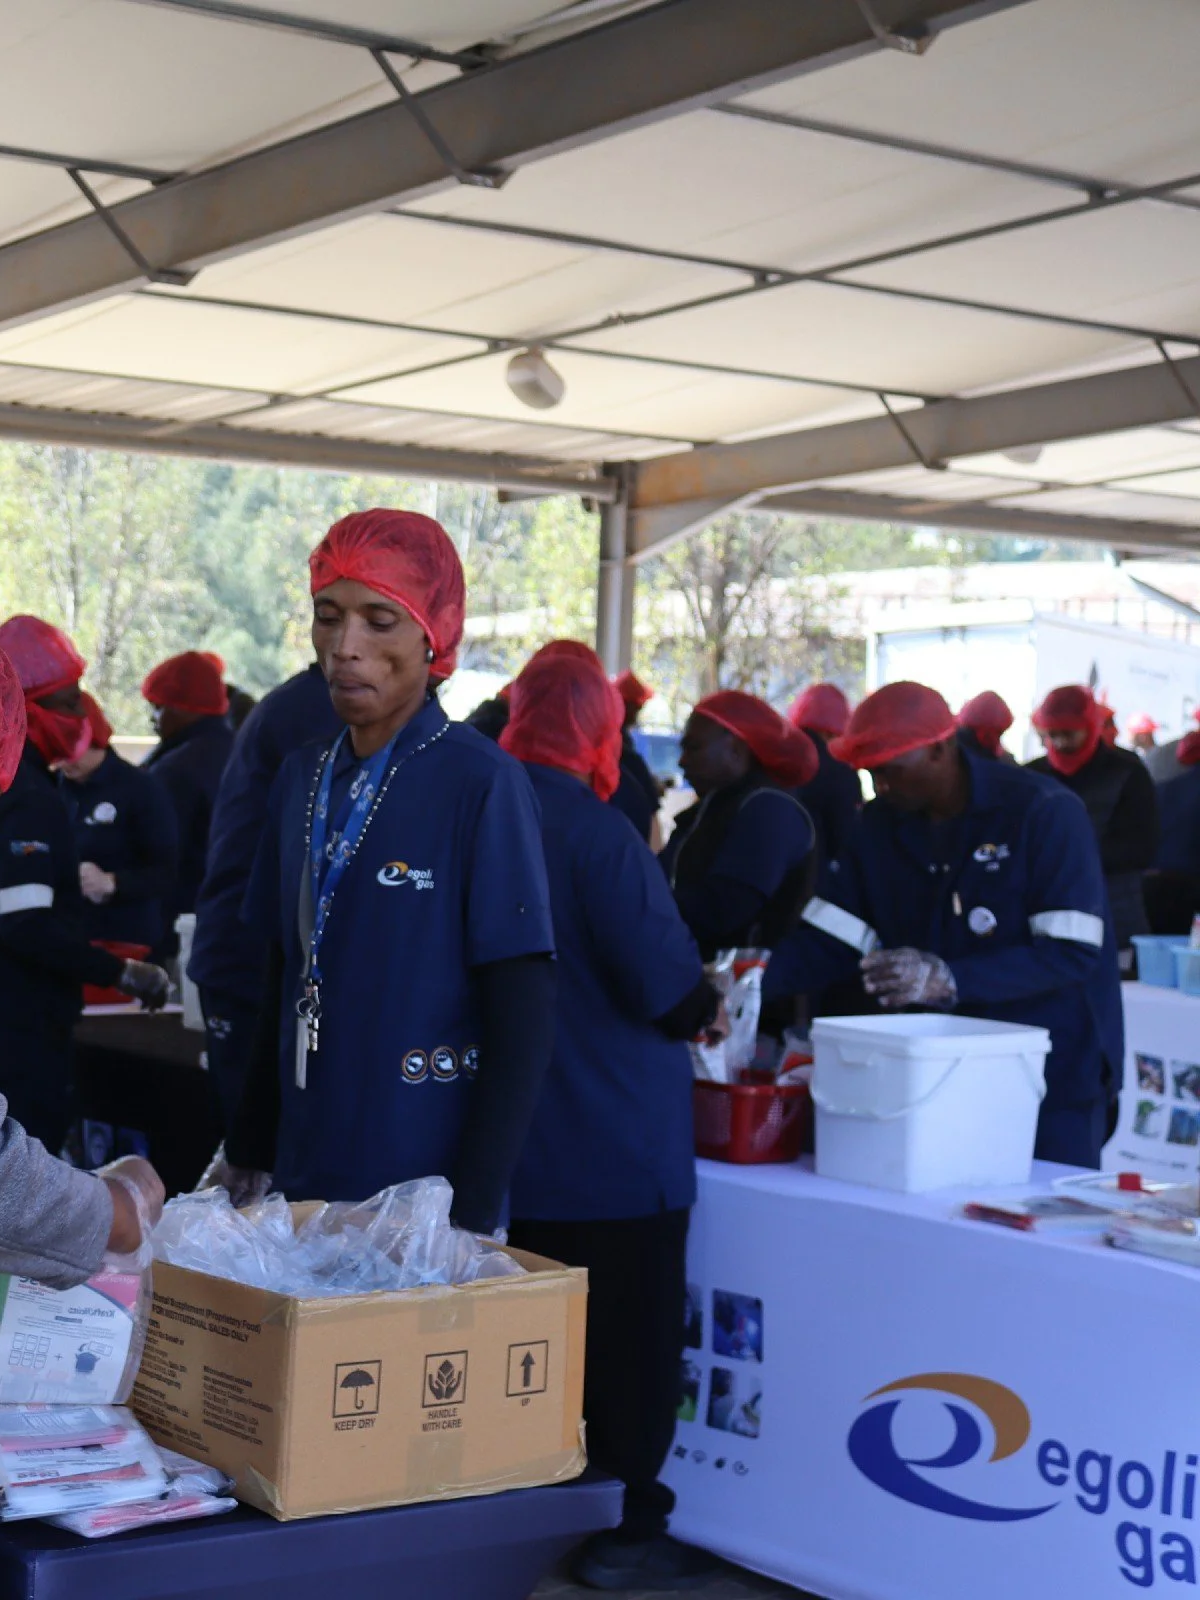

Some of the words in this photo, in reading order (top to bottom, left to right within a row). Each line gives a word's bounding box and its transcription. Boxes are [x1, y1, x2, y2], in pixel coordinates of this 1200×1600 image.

[407, 869, 433, 880] egoli
[416, 880, 435, 890] gas
[152, 1303, 164, 1316] FOR
[165, 1308, 208, 1331] INSTITUTIONAL
[208, 1322, 230, 1337] SALES
[231, 1329, 249, 1342] ONLY
[521, 1398, 531, 1406] UP
[427, 1408, 458, 1420] HANDLE
[334, 1419, 357, 1432] KEEP
[358, 1417, 376, 1430] DRY
[422, 1421, 441, 1432] WITH
[442, 1418, 462, 1430] CARE
[1037, 1438, 1198, 1520] egoli
